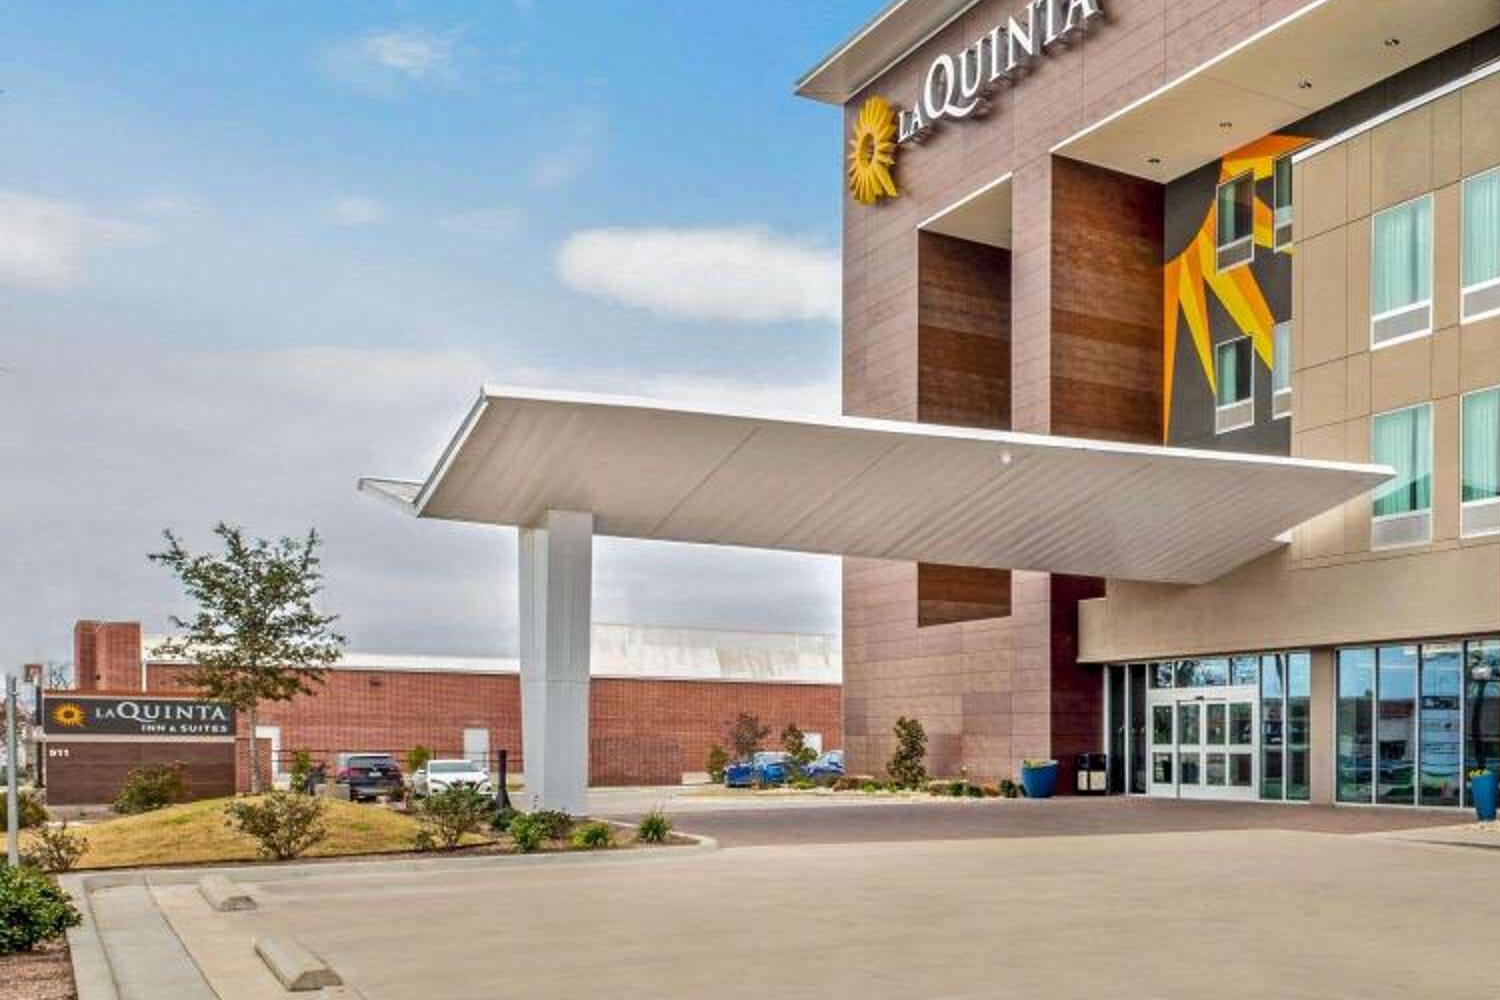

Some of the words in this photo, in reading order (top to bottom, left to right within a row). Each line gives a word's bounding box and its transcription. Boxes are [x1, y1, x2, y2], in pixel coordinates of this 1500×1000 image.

[898, 102, 925, 143] LA
[95, 706, 115, 718] LA
[116, 701, 226, 723] QUINTA
[141, 724, 165, 733] INN
[181, 724, 227, 733] SUITES
[49, 748, 69, 757] 911
